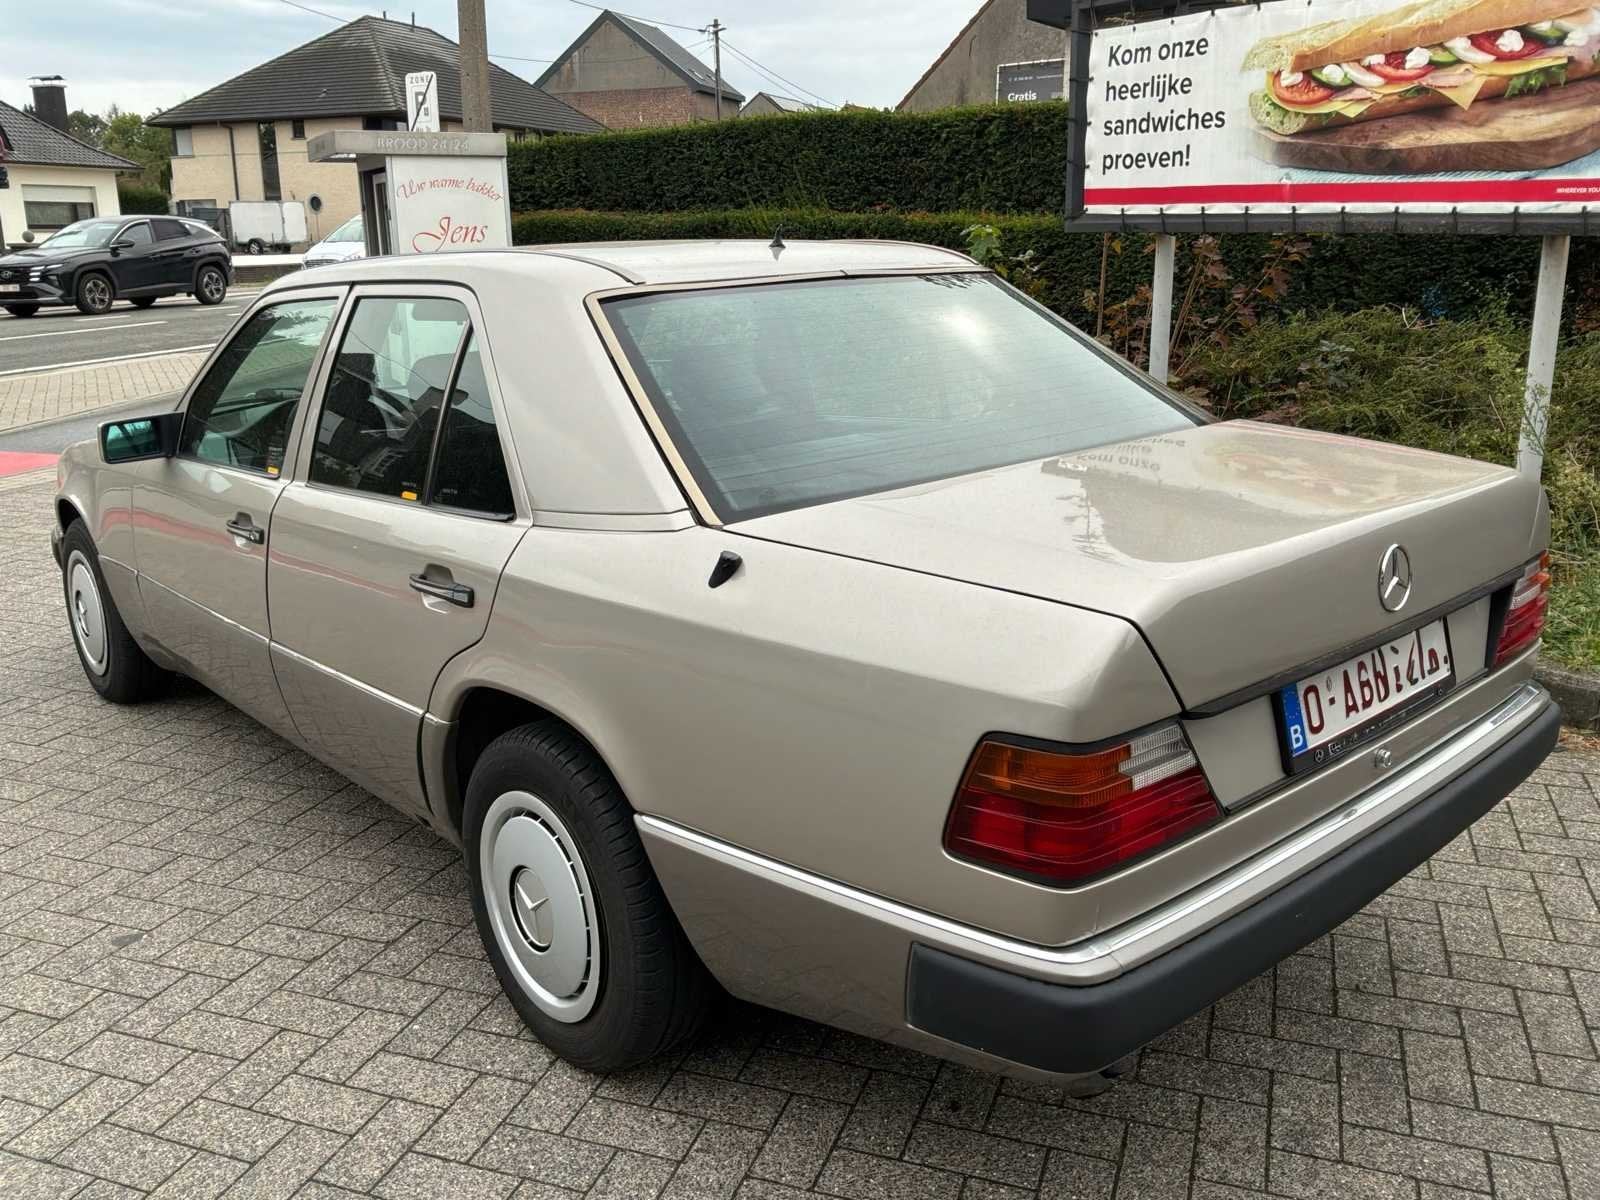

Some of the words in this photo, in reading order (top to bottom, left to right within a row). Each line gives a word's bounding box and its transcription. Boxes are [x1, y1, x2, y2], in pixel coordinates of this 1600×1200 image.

[1107, 45, 1152, 67] Kom
[1158, 37, 1209, 60] onze
[1008, 91, 1037, 102] Gratis
[1105, 71, 1193, 103] heerlijke
[1103, 108, 1226, 136] sandwiches
[1102, 144, 1191, 174] proeven!
[429, 178, 465, 190] warme
[466, 177, 503, 201] bakker
[1290, 726, 1304, 749] B
